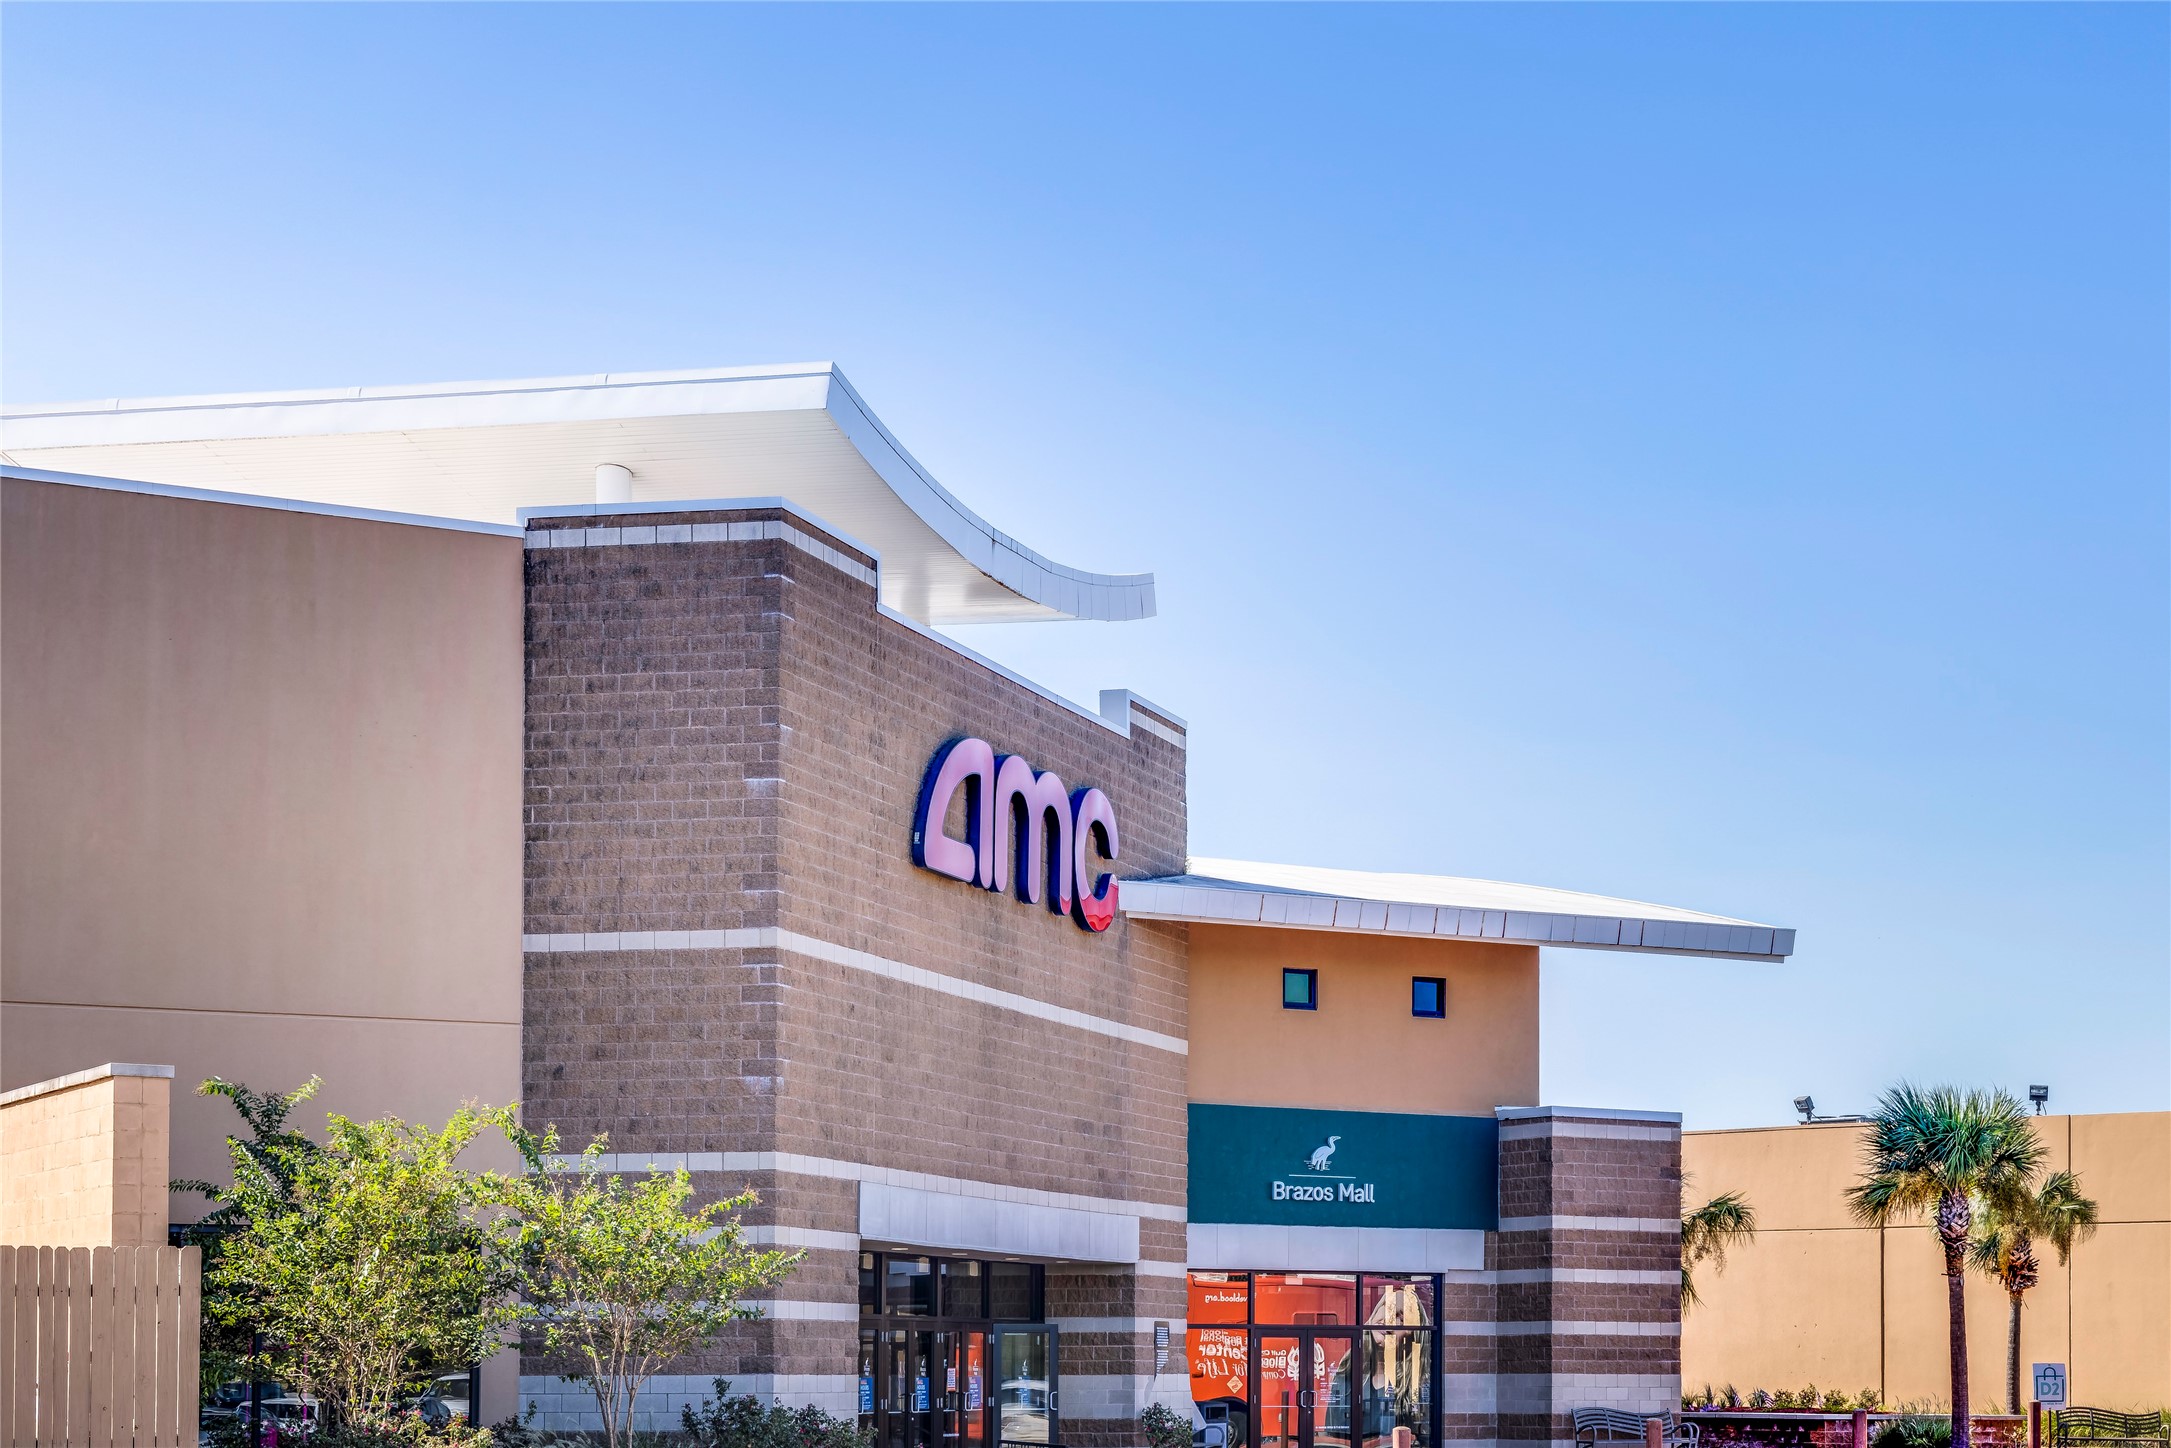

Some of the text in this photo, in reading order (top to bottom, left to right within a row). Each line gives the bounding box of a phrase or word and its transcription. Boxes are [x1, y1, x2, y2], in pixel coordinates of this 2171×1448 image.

[1271, 1180, 1376, 1203] Brazos Mall
[2040, 1382, 2060, 1396] D2
